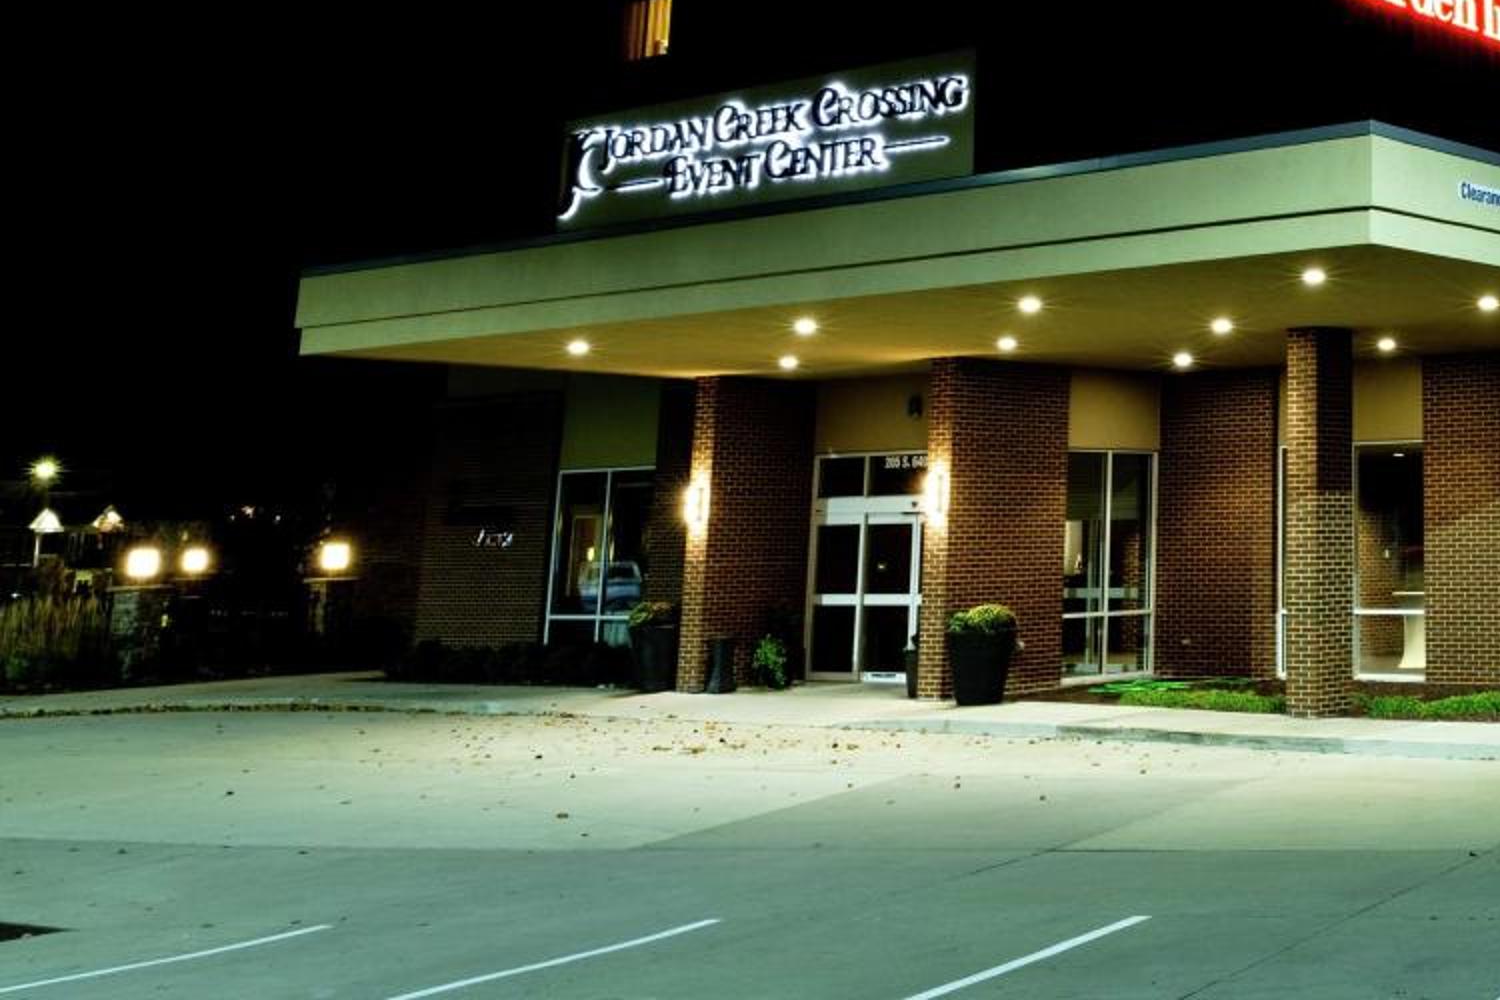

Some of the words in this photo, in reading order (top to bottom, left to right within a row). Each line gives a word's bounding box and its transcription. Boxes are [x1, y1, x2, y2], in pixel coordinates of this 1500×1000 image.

[713, 103, 806, 144] CREEK
[811, 76, 965, 127] CROSSING
[663, 153, 761, 193] EVENT
[764, 137, 882, 180] CENTER
